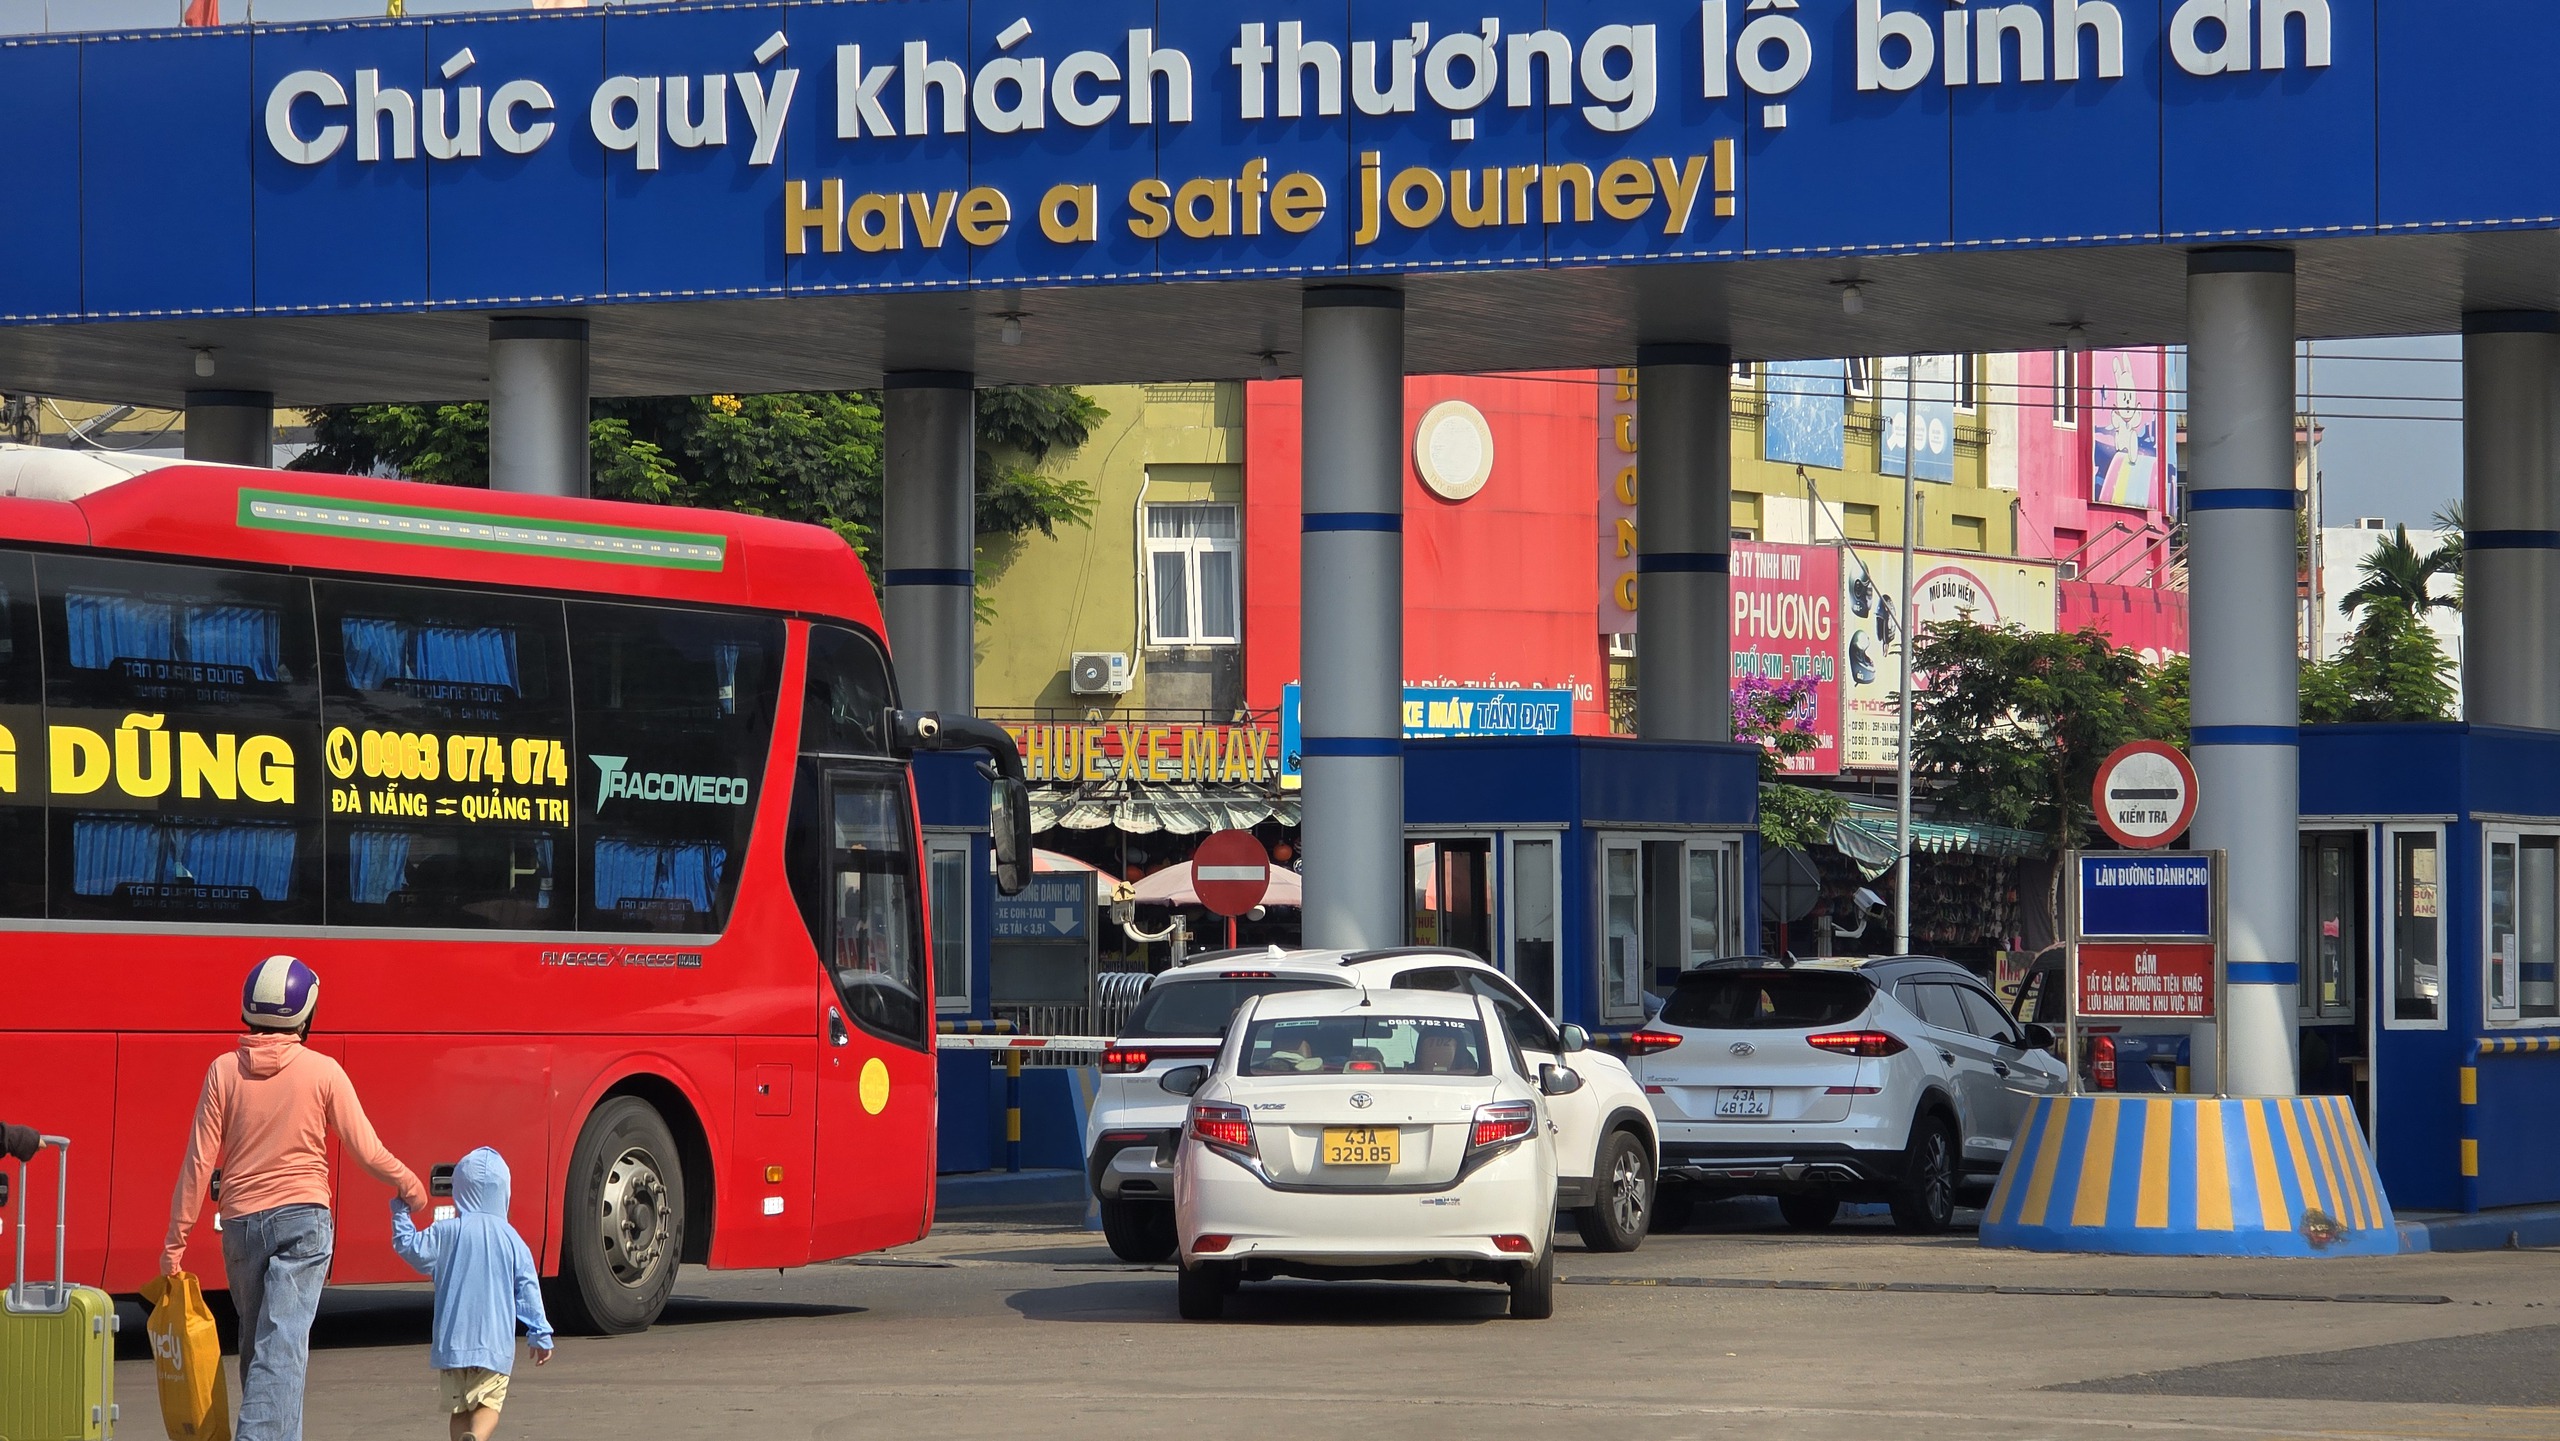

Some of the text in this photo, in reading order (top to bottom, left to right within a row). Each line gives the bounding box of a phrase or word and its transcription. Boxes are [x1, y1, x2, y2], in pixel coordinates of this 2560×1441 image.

[265, 47, 556, 165] Chúc
[590, 30, 800, 171] quý
[836, 17, 1193, 139] khách
[1231, 17, 1658, 141] thượng
[1703, 0, 1812, 128] lộ
[785, 138, 1735, 255] Have a safe journey!
[1742, 551, 1753, 578] TY
[1755, 552, 1779, 580] TNHH
[1781, 554, 1801, 581] MTV
[1942, 577, 1957, 599] BẢO
[1734, 591, 1831, 641] PHƯƠNG
[1734, 643, 1760, 679] PHỐI
[1762, 652, 1783, 680] SIM
[1428, 697, 1474, 729] MÁY
[1477, 693, 1517, 730] TẤN
[1520, 703, 1560, 736] ĐẠT
[49, 713, 295, 804] DŨNG
[361, 730, 568, 787] 0963 074 074
[1116, 726, 1170, 783] XE
[1181, 709, 1271, 783] MÁY
[588, 754, 748, 815] TRACOMECO
[332, 783, 569, 827] ĐÀ NẴNG QUẢNG TRỊ
[2119, 802, 2168, 824] KIỂM TRA
[2095, 863, 2207, 887] LÀN ĐƯỜNG DÀNH CHO
[1040, 880, 1063, 902] DÀNH
[1064, 883, 1081, 902] CHO
[1010, 920, 1022, 935] TẢI
[2135, 948, 2157, 975] CẤM
[2087, 969, 2203, 994] TẤT CẢ CÁC PHƯƠNG TIỆN KHÁC
[2087, 992, 2203, 1013] LƯU HÀNH TRONG KHU VỰC NÀY
[1721, 1103, 1764, 1114] 481.24
[1733, 1089, 1755, 1102] 43A
[1345, 1129, 1377, 1145] 43A
[1331, 1146, 1391, 1162] 329.85
